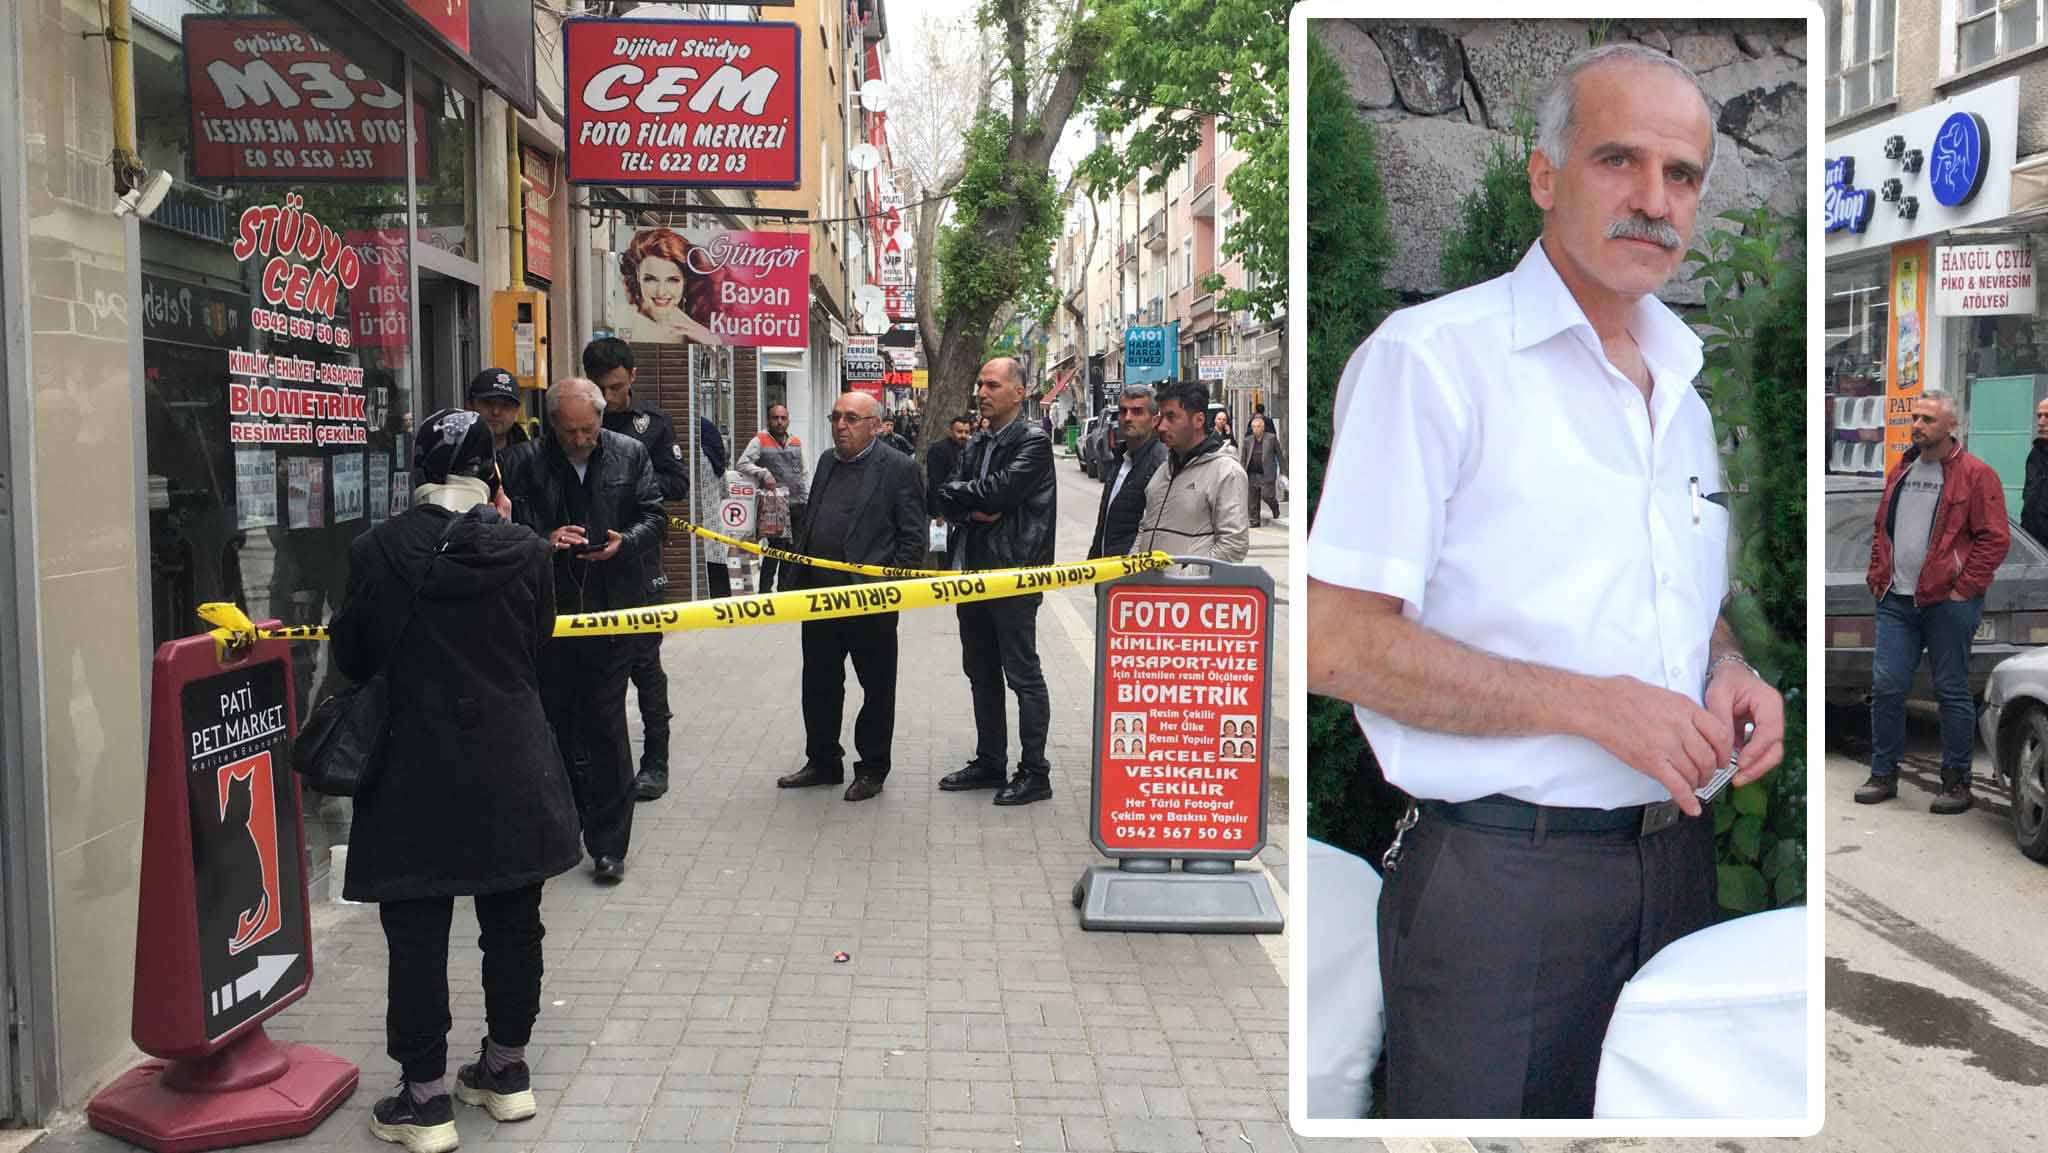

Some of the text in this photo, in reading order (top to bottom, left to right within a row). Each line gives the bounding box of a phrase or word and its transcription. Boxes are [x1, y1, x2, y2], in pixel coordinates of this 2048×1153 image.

[613, 37, 751, 63] Dijital Stüdyo
[582, 62, 780, 116] CEM
[579, 114, 788, 149] FOTO FİLM MERKEZİ
[621, 151, 747, 173] TEL: 622 02 03
[233, 192, 360, 289] STÜDYO
[687, 236, 805, 278] Güngör
[262, 256, 340, 321] CEM
[1941, 273, 1965, 290] PİKO
[1979, 272, 2031, 290] NEVRESİM
[721, 281, 790, 306] Bayan
[252, 307, 288, 336] 0542
[289, 316, 314, 340] 567
[317, 322, 333, 345] 50
[335, 327, 351, 348] 63
[709, 311, 801, 337] Kuaförü
[1129, 331, 1162, 341] A-101
[1129, 341, 1161, 349] HARCA
[229, 347, 269, 376] KİMLİK
[275, 355, 315, 382] EHLİYET
[321, 363, 364, 387] PASAPORT
[229, 378, 366, 420] BİOMETRİK
[231, 420, 367, 447] RESİMLERİ ÇEKİLİR
[807, 586, 902, 613] GİRİLMEZ
[931, 578, 986, 602] POLİS
[713, 599, 776, 623] POLİS
[1120, 600, 1252, 630] FOTO CEM
[1110, 635, 1259, 653] KİMLİK-EHLİYET
[1110, 654, 1257, 671] PASAPORT-VİZE
[221, 681, 252, 717] PATİ
[1118, 679, 1248, 707] BİOMETRİK
[1150, 709, 1216, 721] Resim Çekilir
[1160, 720, 1204, 731] Her Ülke
[192, 704, 283, 755] PET MARKET
[1149, 734, 1214, 746] Resmi Yapılır
[1148, 750, 1217, 763] ACELE
[1125, 764, 1239, 780] VESİKALIK
[1139, 782, 1224, 797] ÇEKİLİR
[1126, 797, 1234, 811] Her Türlü Fotoğraf
[1111, 811, 1145, 823] Çekim
[1150, 813, 1163, 822] ve
[1211, 812, 1248, 824] Yapılır
[1116, 826, 1242, 840] 0542 567 50 63
